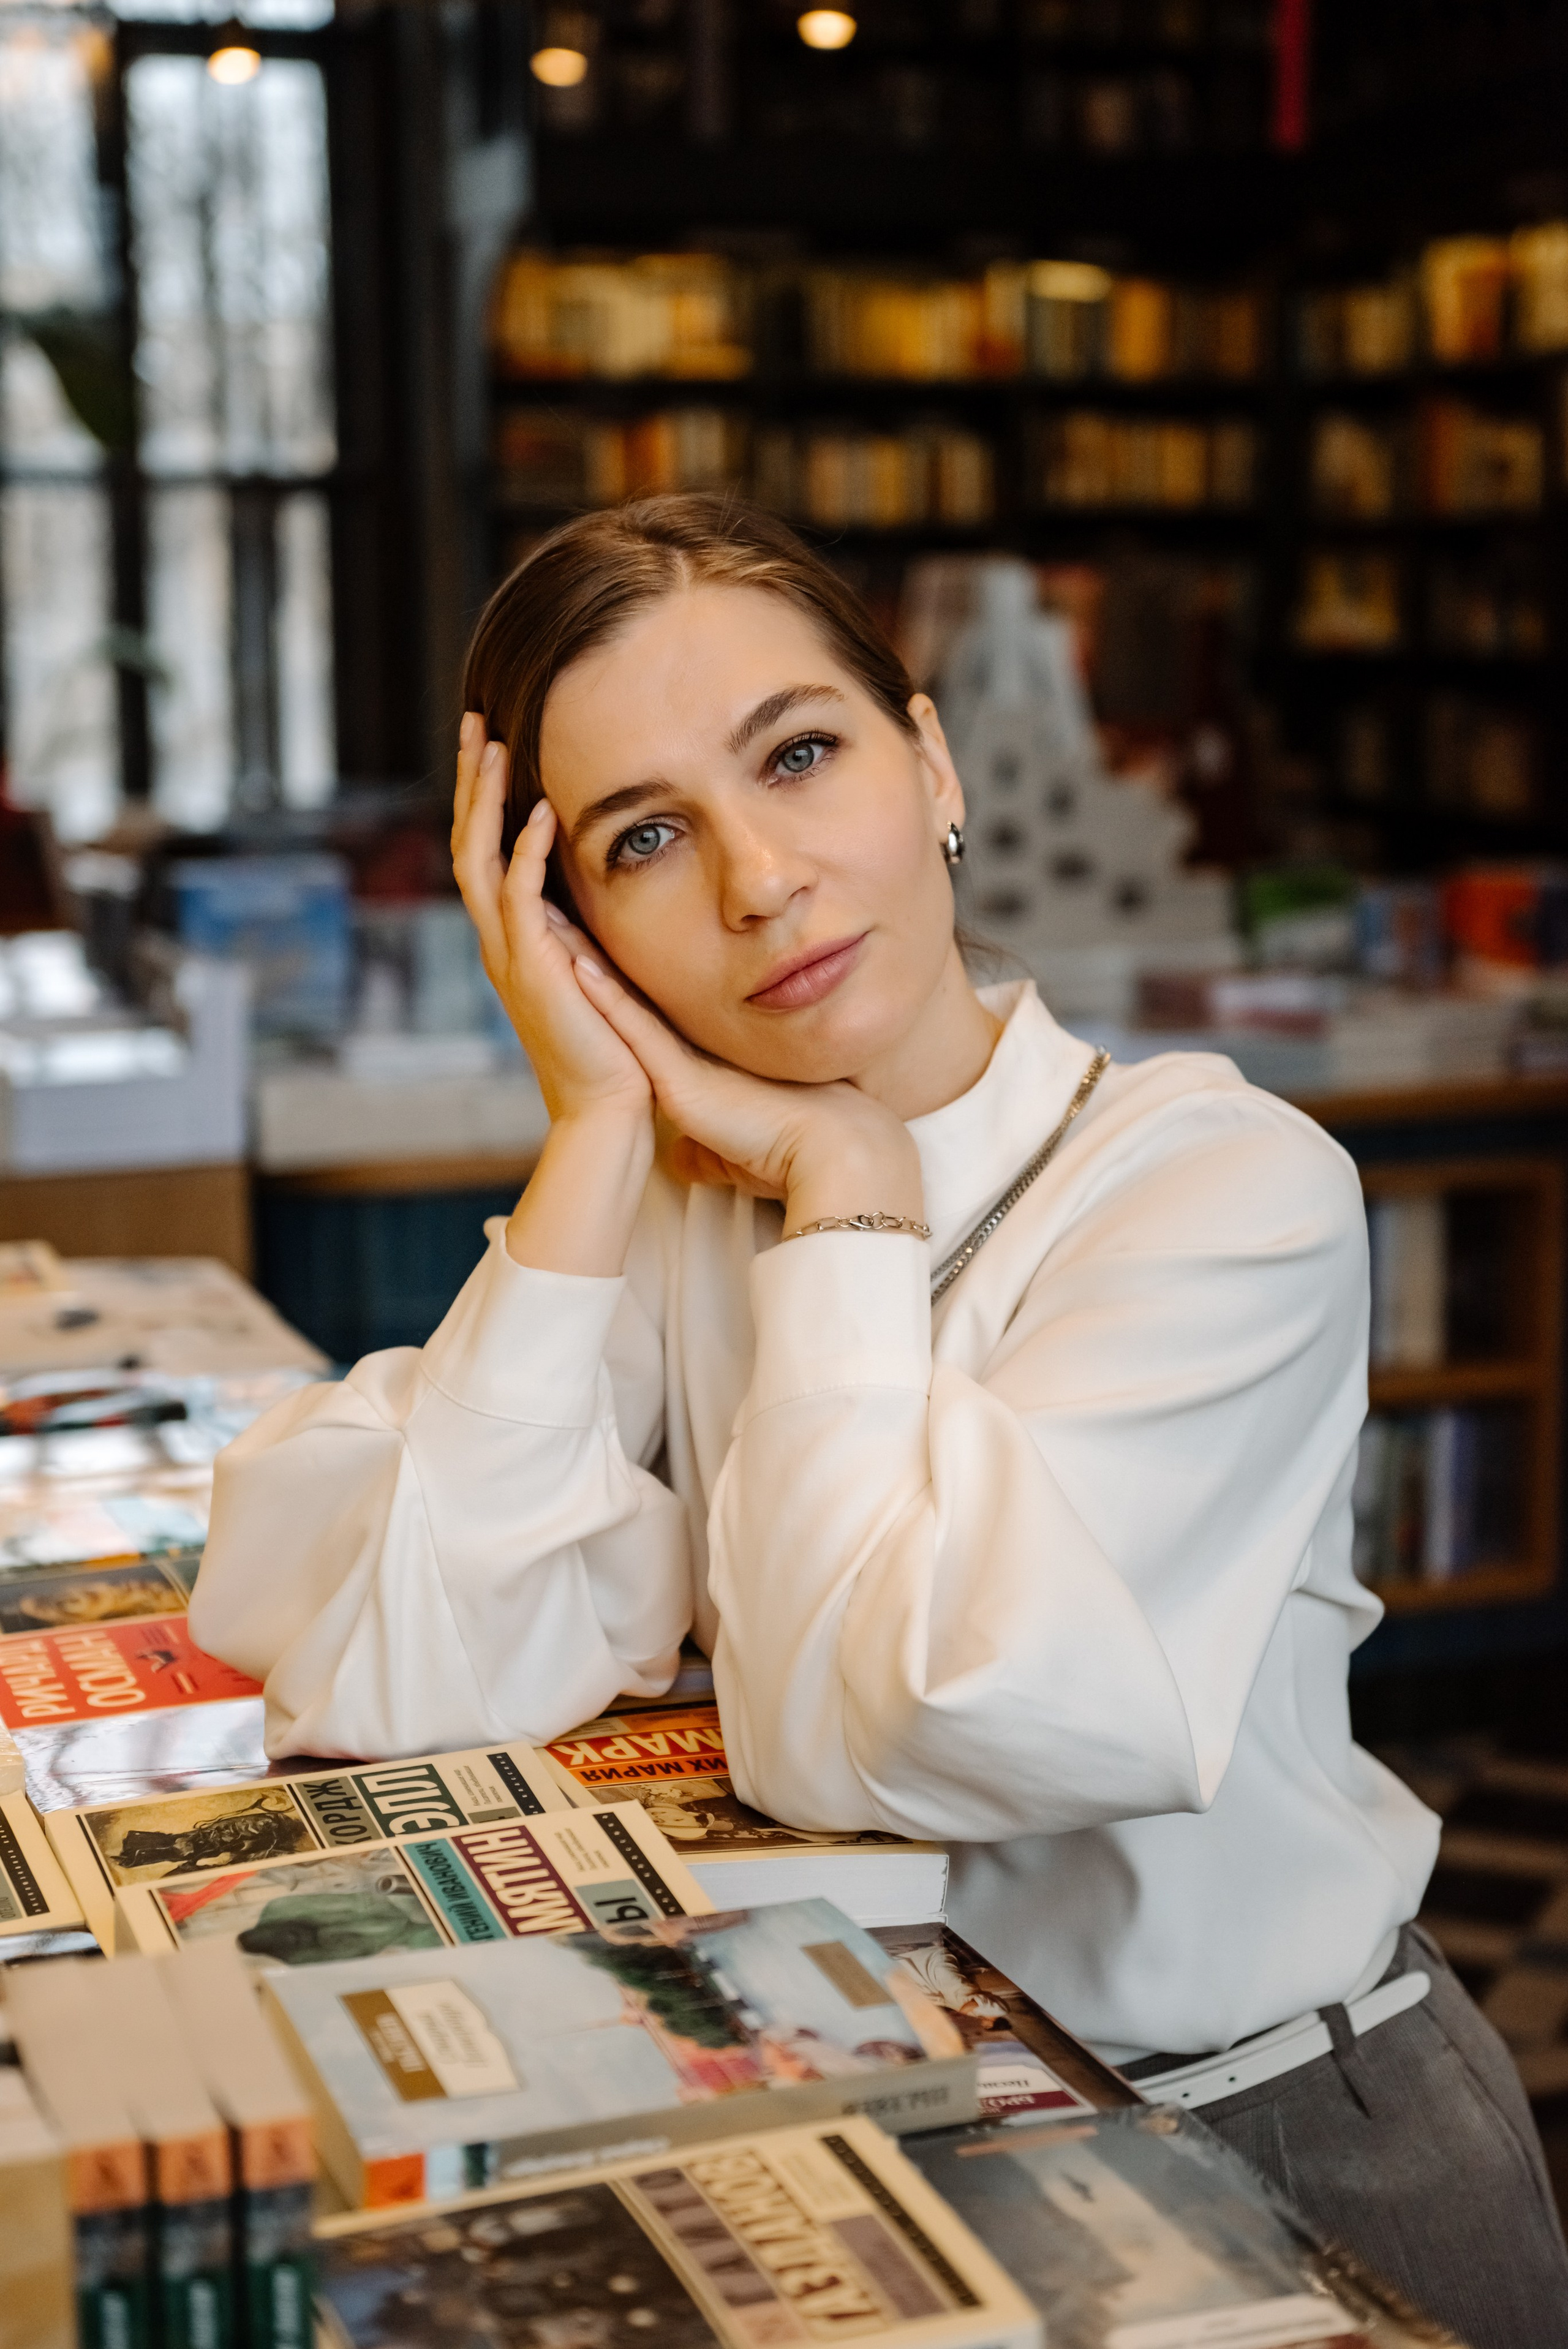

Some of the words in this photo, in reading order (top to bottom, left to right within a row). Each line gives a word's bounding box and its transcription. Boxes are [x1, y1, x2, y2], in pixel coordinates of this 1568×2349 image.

[0, 1638, 76, 1719] РИЧАРД
[53, 1629, 146, 1708] ОСМАН
[552, 1727, 725, 1766] МАРК
[579, 1761, 685, 1782] МАРИЯ
[414, 1842, 470, 1902] ИВАНОВИЧ
[461, 1828, 586, 1934] МЯТИН
[686, 2149, 894, 2342] ГАЗДАНОВ
